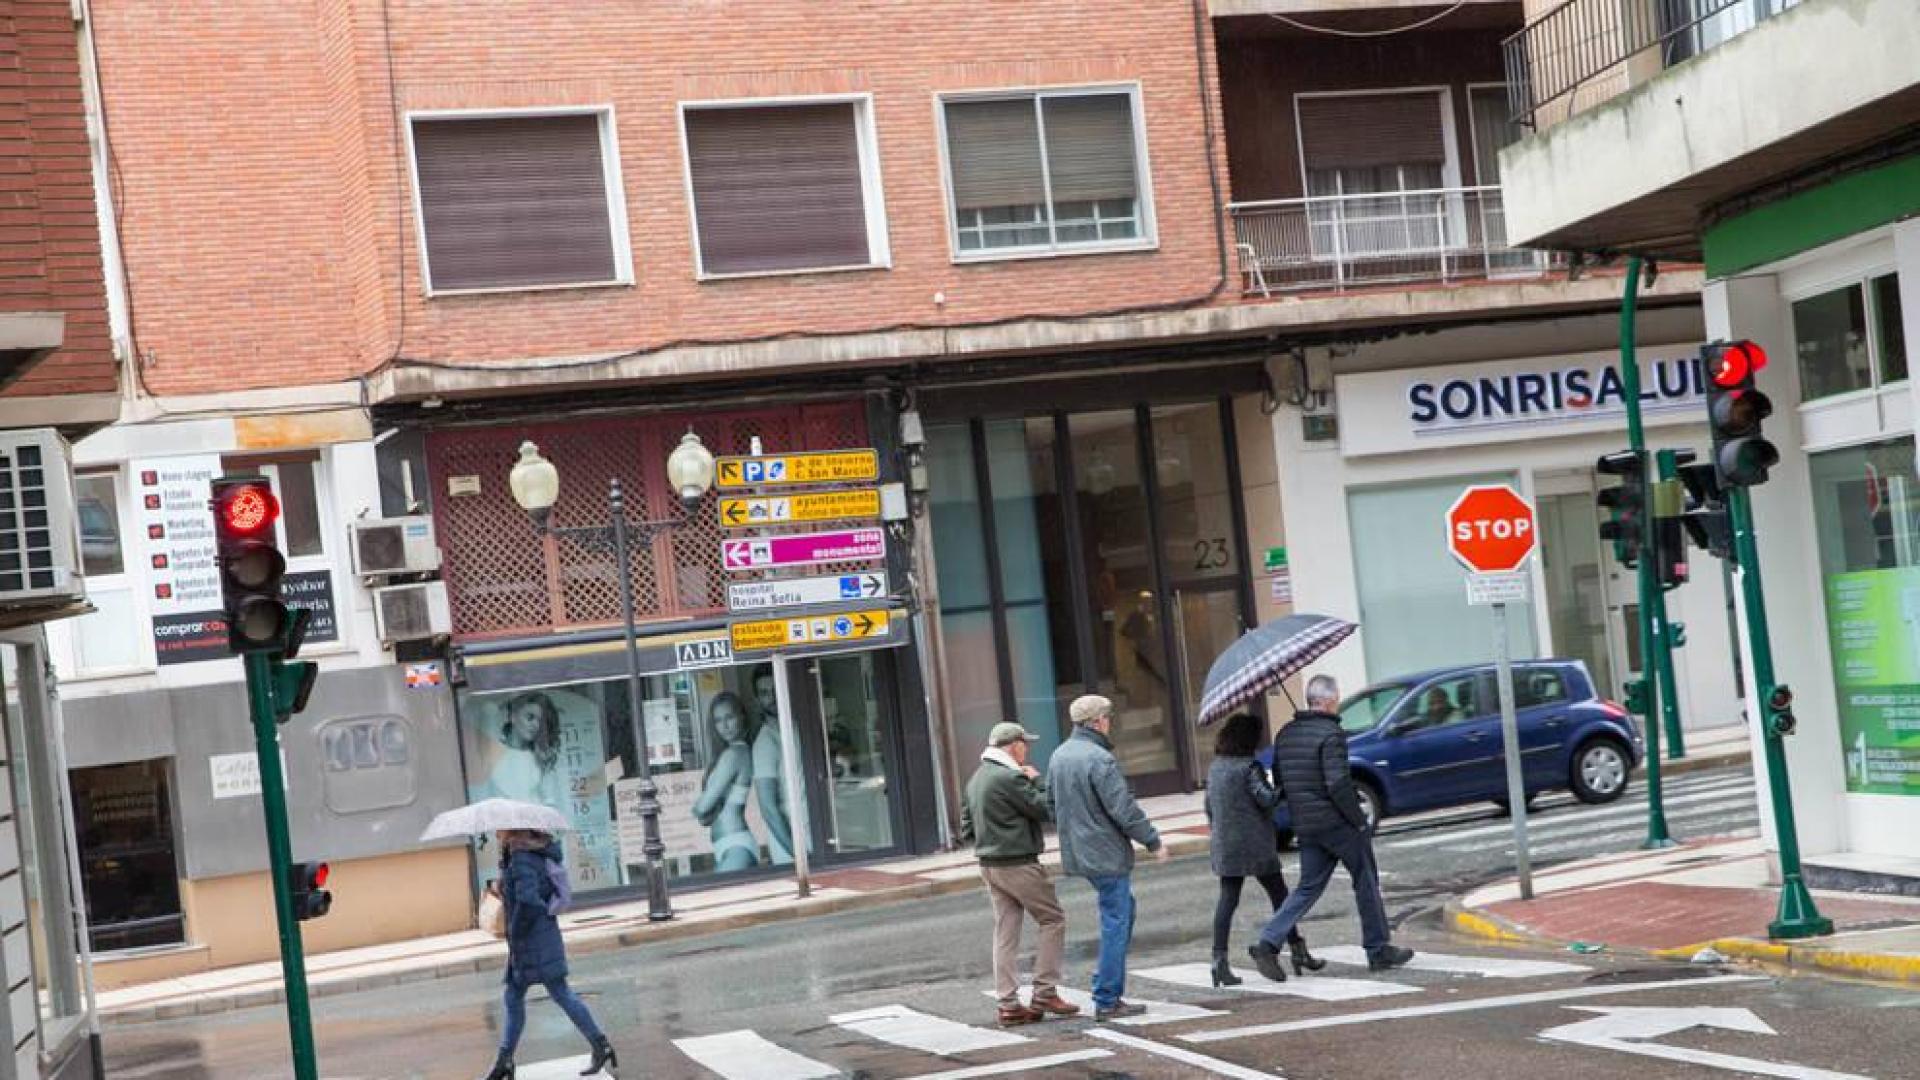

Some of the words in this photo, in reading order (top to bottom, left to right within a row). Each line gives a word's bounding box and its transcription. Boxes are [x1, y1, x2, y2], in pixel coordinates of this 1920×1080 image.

[809, 467, 829, 478] San
[833, 465, 874, 477] Marcial
[797, 491, 876, 507] ayuntamiento
[852, 530, 881, 543] zona
[1456, 518, 1529, 541] STOP
[812, 543, 881, 559] monumental
[1194, 537, 1230, 569] 23
[731, 583, 775, 596] hospital
[732, 597, 766, 609] Reina
[684, 641, 726, 660] ADN
